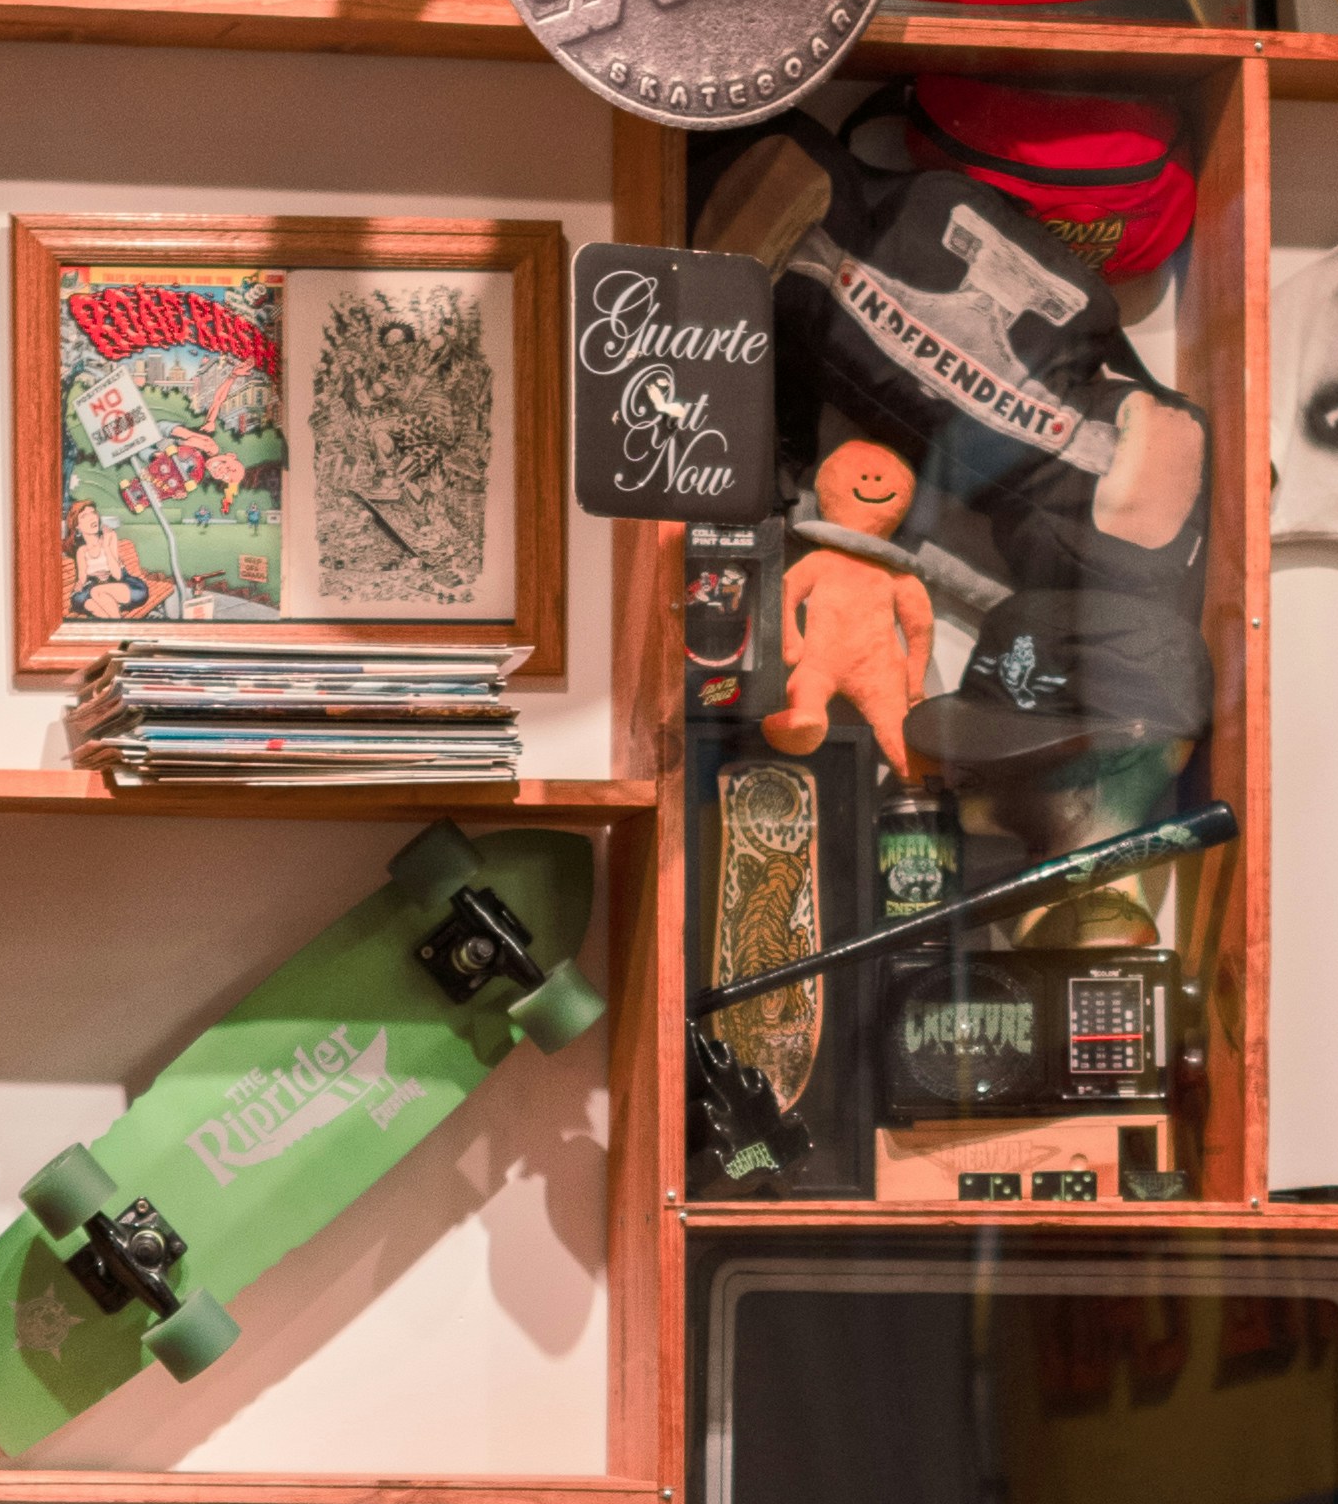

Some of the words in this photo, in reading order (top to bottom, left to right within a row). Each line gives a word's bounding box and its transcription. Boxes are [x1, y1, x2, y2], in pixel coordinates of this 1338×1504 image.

[848, 280, 1053, 438] INDEPENDENT
[88, 388, 123, 417] NO
[613, 429, 736, 497] Now
[903, 1000, 1035, 1056] CREATURE
[184, 1023, 362, 1189] Riprider
[224, 1066, 268, 1106] THE
